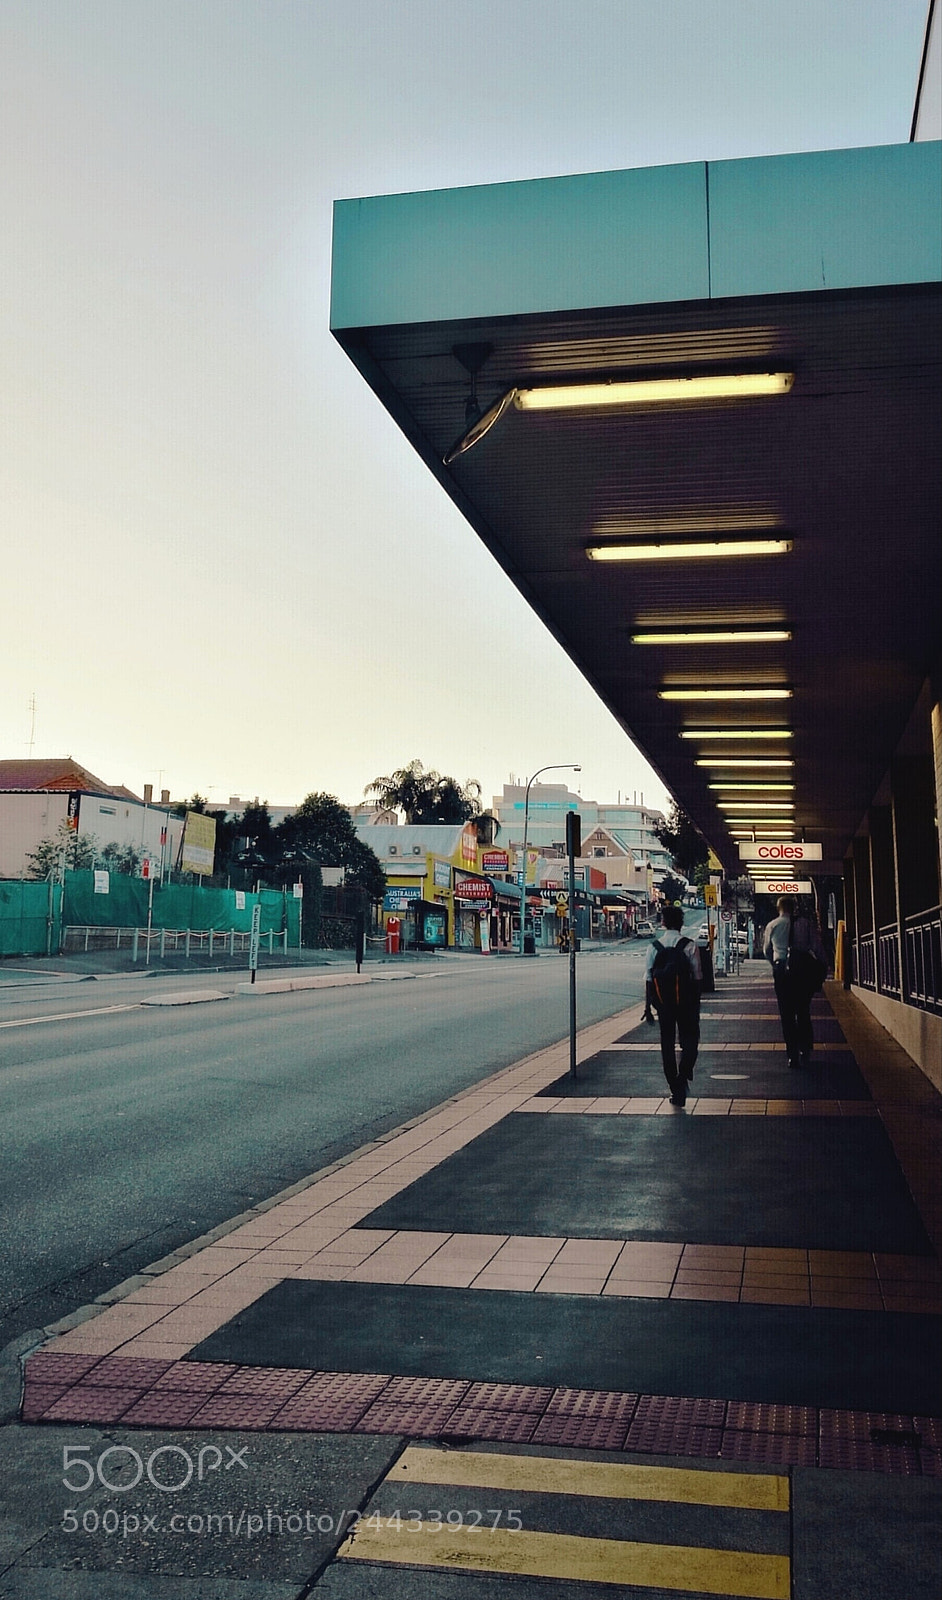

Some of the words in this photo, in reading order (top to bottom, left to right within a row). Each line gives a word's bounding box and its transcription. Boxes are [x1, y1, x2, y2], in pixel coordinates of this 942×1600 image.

[758, 845, 804, 858] coles
[457, 883, 491, 891] CHEMIST
[767, 882, 799, 892] coles
